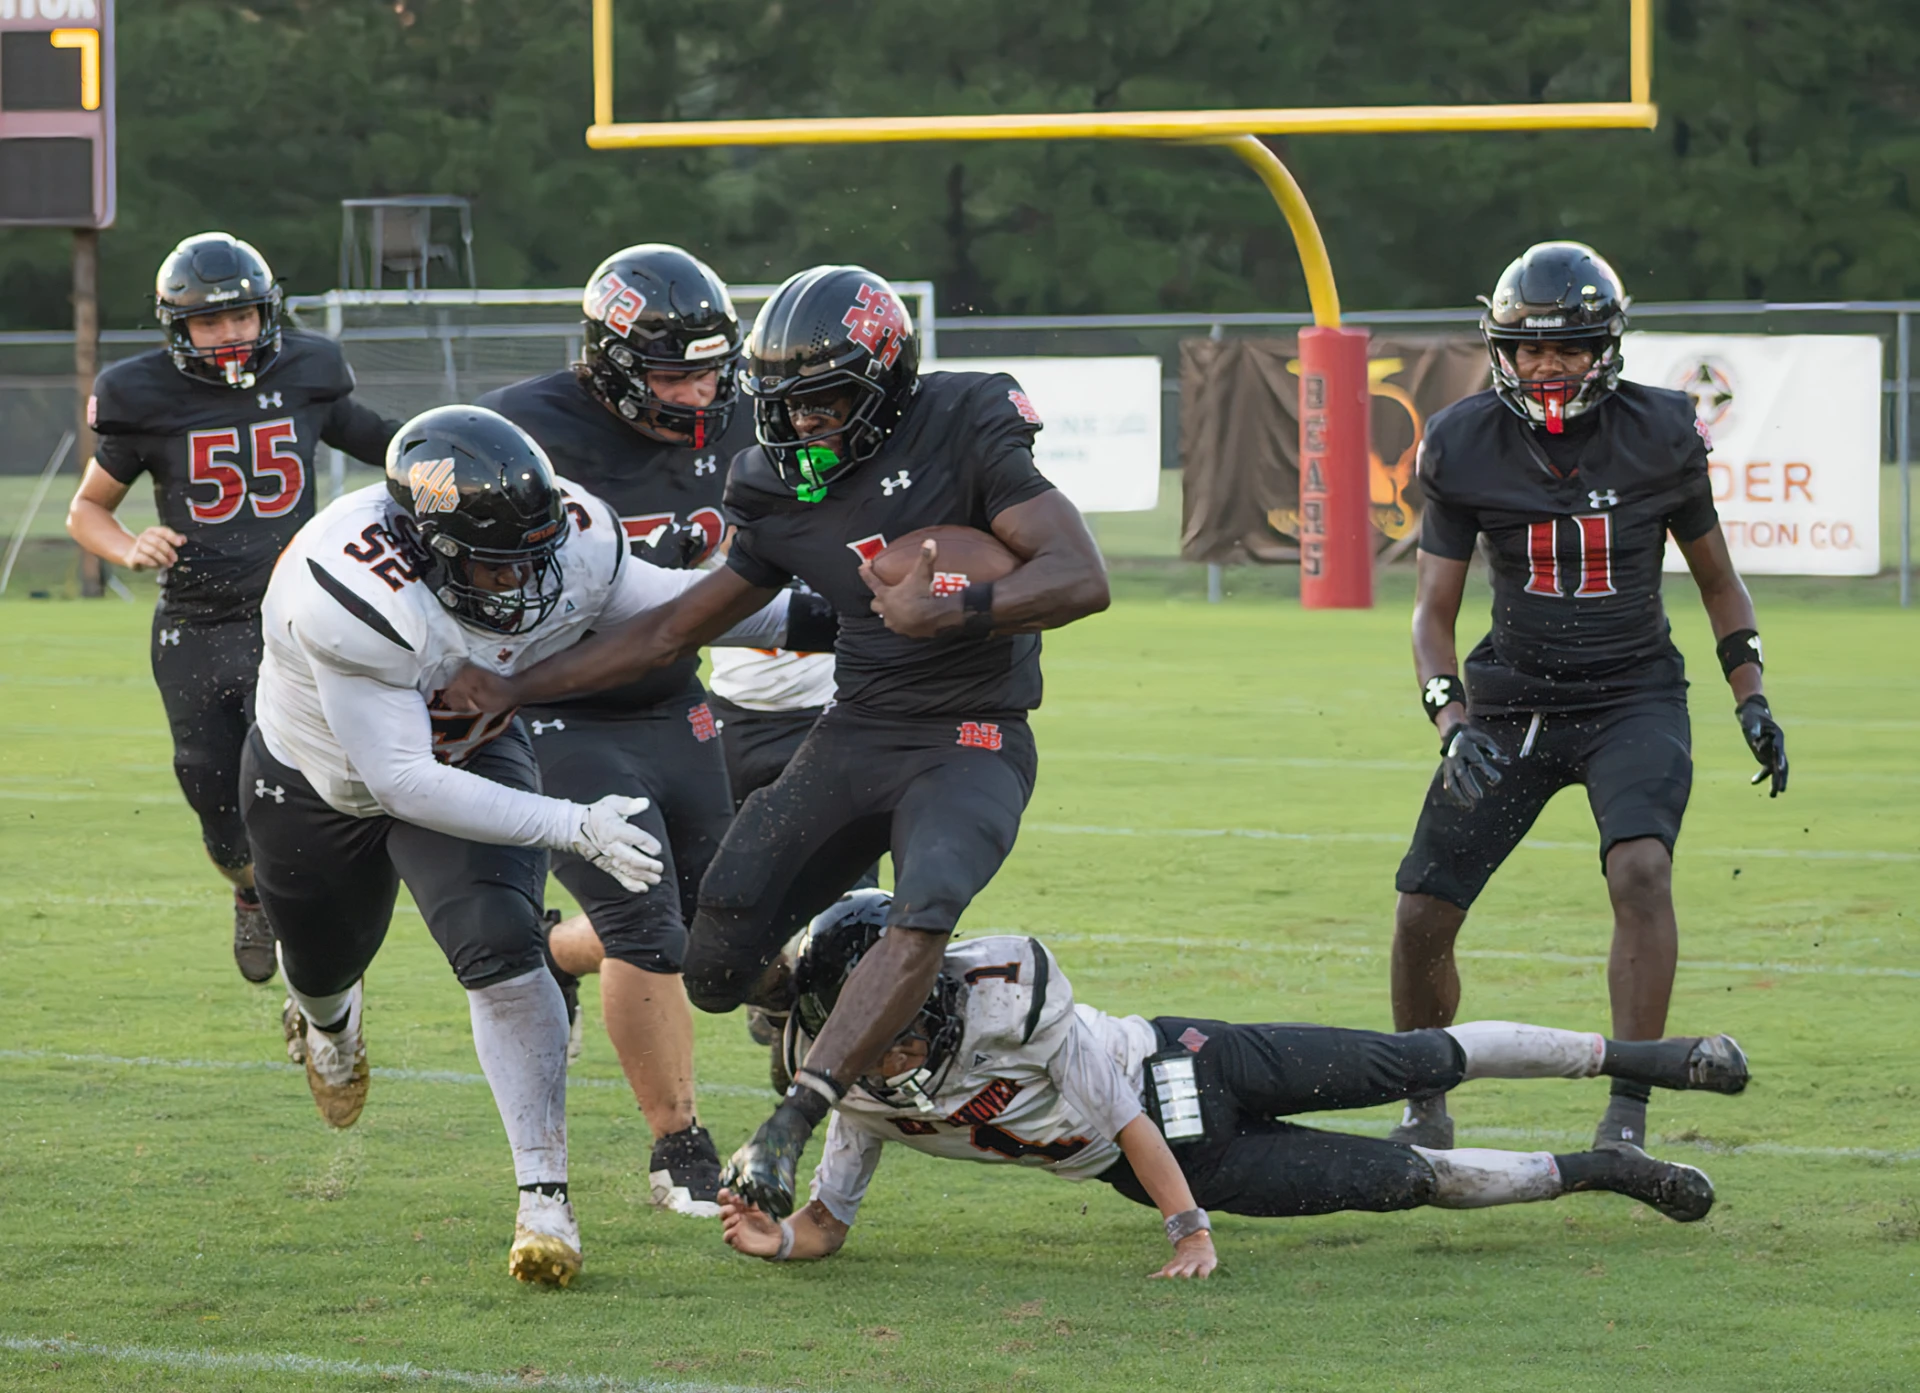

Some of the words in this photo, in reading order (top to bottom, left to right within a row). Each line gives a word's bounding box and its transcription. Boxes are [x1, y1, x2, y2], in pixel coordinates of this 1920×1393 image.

[50, 28, 100, 111] 7
[594, 271, 647, 339] 72
[186, 417, 305, 524] 55
[1303, 375, 1327, 577] BEARS
[1708, 462, 1813, 502] DER
[344, 522, 420, 592] 52
[1524, 512, 1617, 598] 11
[965, 961, 1021, 985] 1
